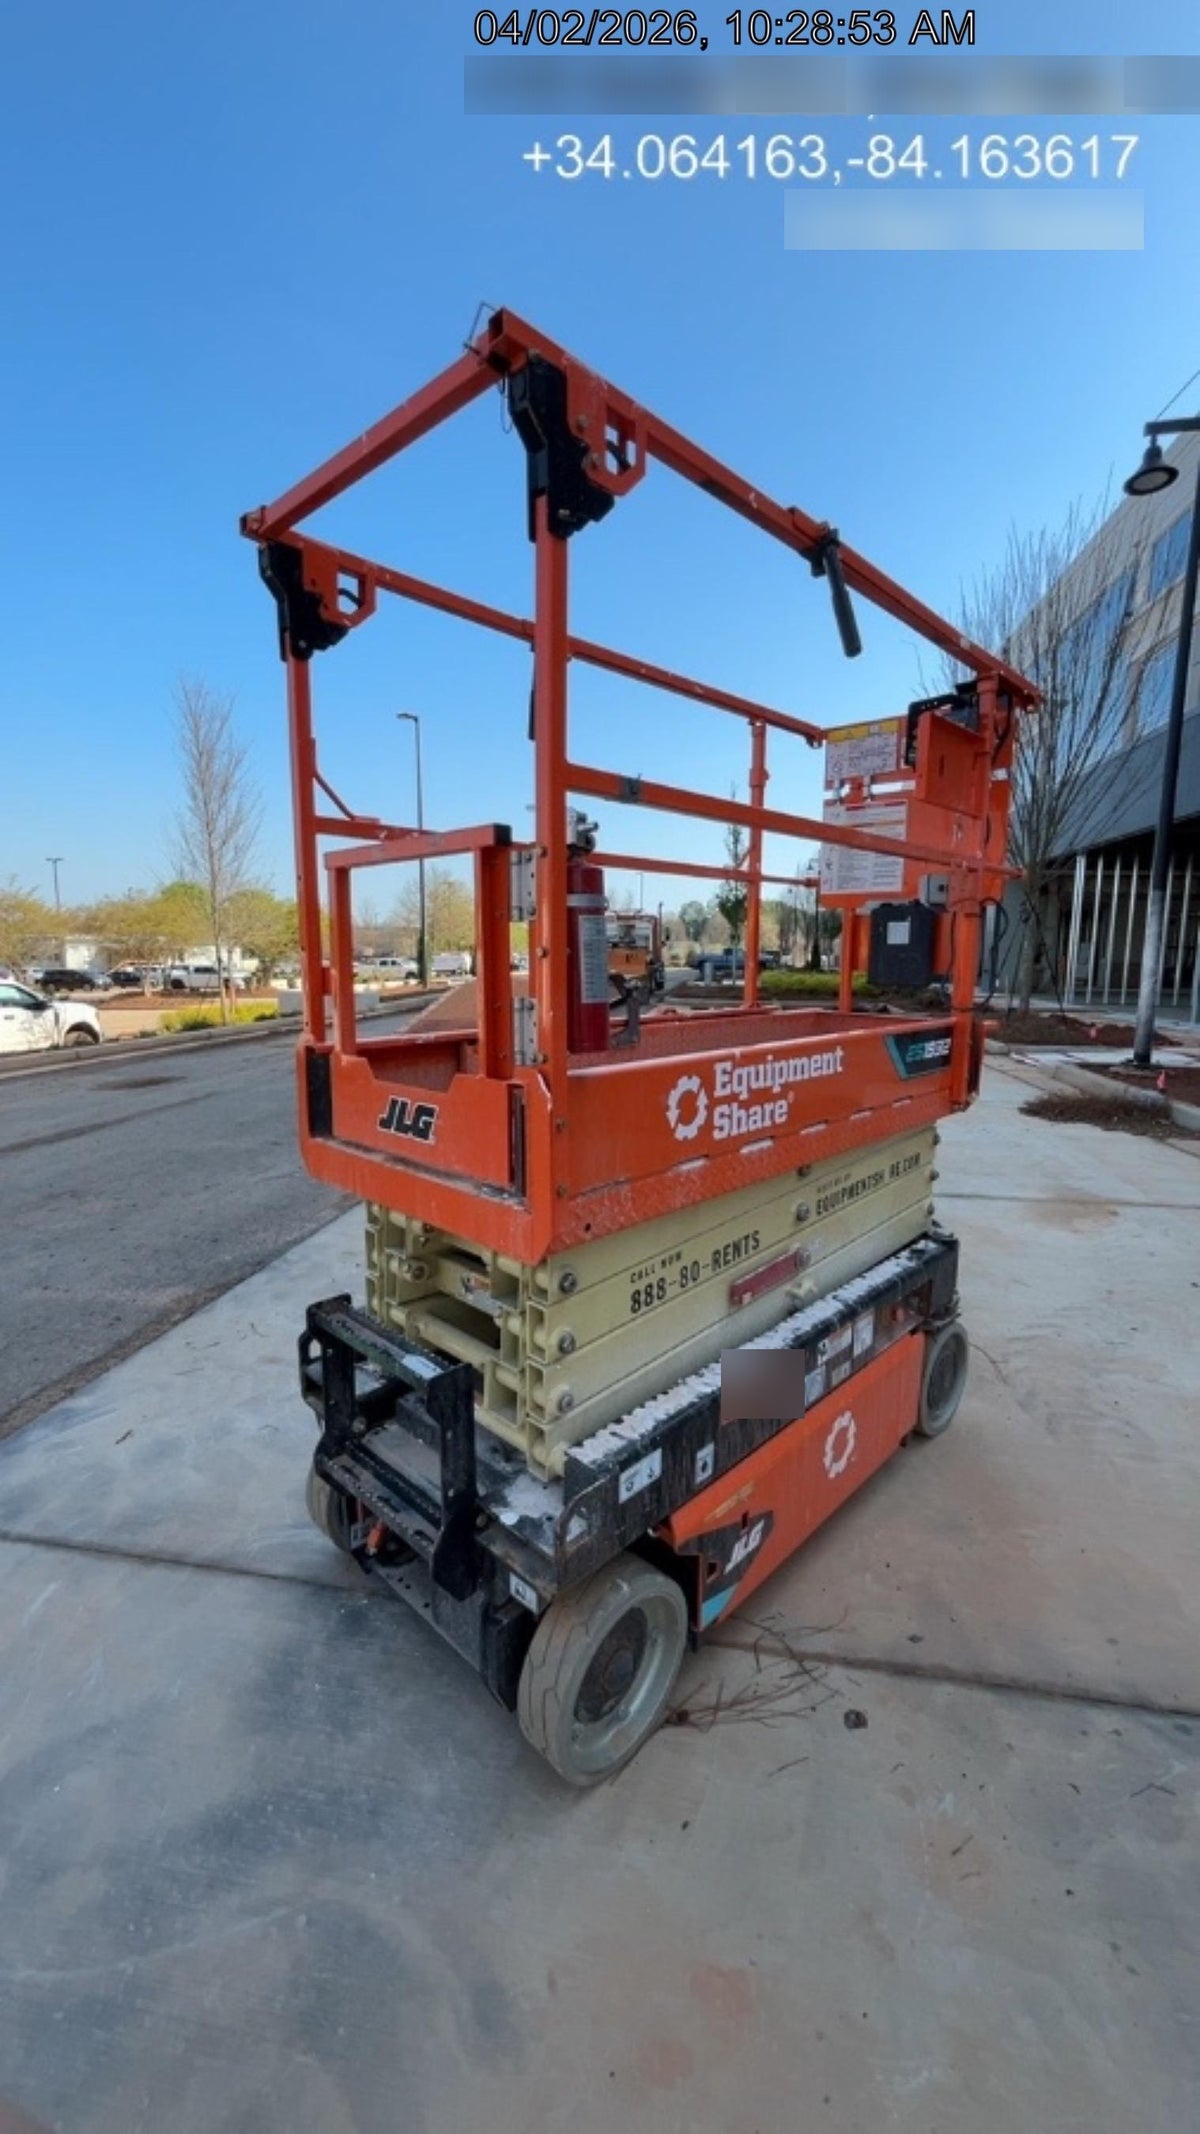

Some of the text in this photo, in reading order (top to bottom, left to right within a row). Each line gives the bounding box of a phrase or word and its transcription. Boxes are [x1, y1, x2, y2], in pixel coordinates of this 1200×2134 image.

[713, 1046, 844, 1100] Equipment
[377, 1094, 439, 1145] JLG
[630, 1251, 682, 1283] CALL NOW
[630, 1229, 760, 1314] 888-80-RENTS
[723, 1519, 765, 1575] JLG
